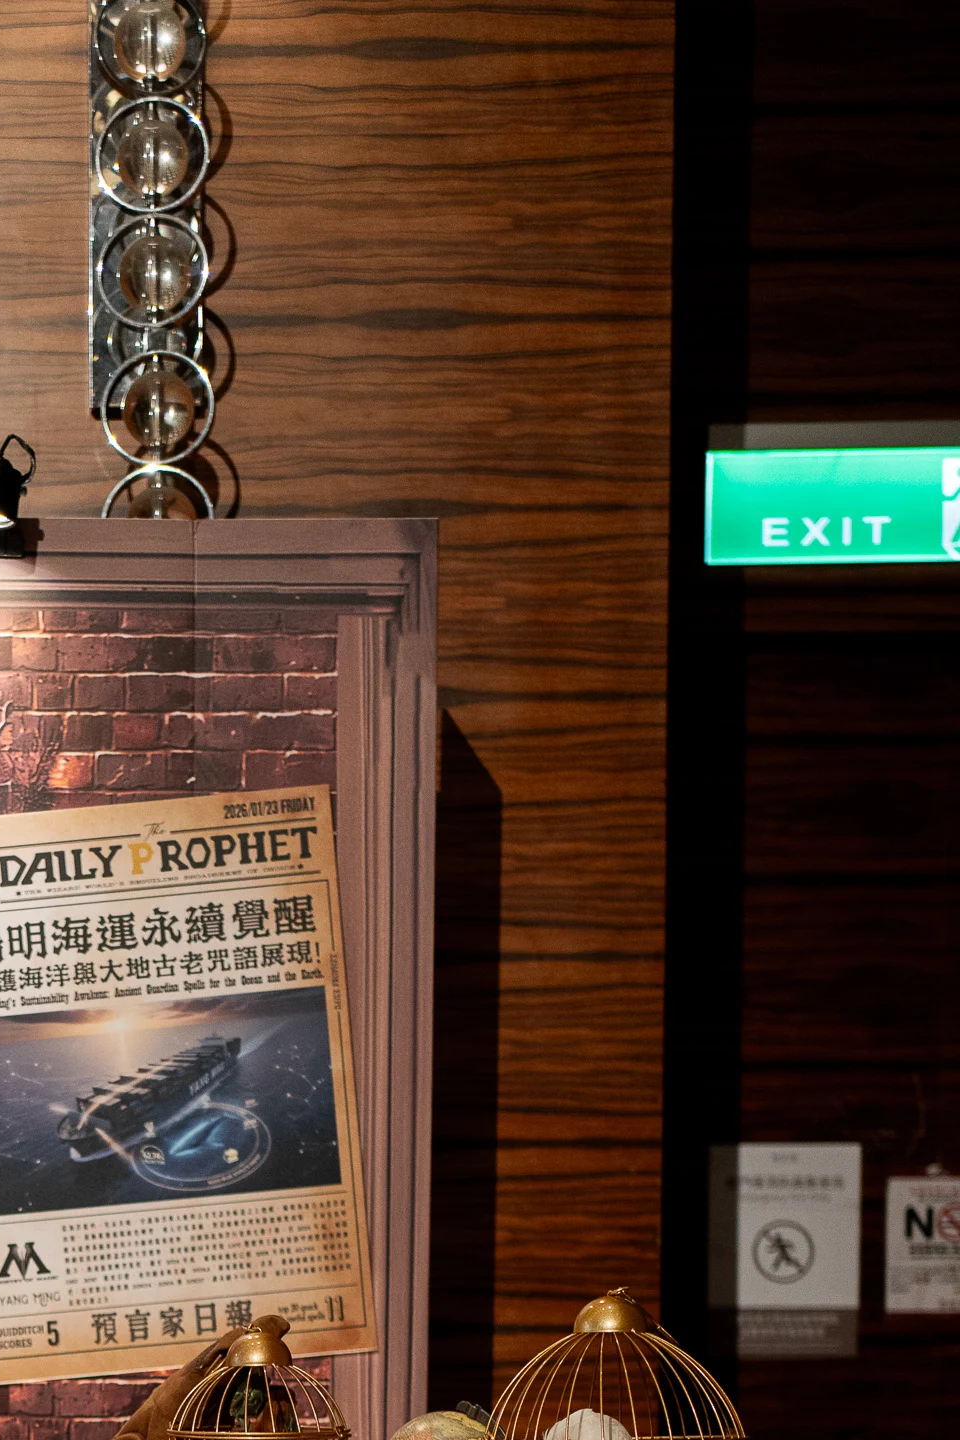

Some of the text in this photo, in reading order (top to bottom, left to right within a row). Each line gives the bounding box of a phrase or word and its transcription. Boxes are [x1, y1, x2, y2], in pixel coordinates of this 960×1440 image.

[761, 516, 892, 547] EXIT
[222, 795, 316, 819] 2026/01/23 FRIDAY
[127, 825, 319, 875] PROPHET
[32, 1290, 61, 1307] MING
[45, 1319, 60, 1347] 5
[90, 1298, 254, 1346] 預言家日報
